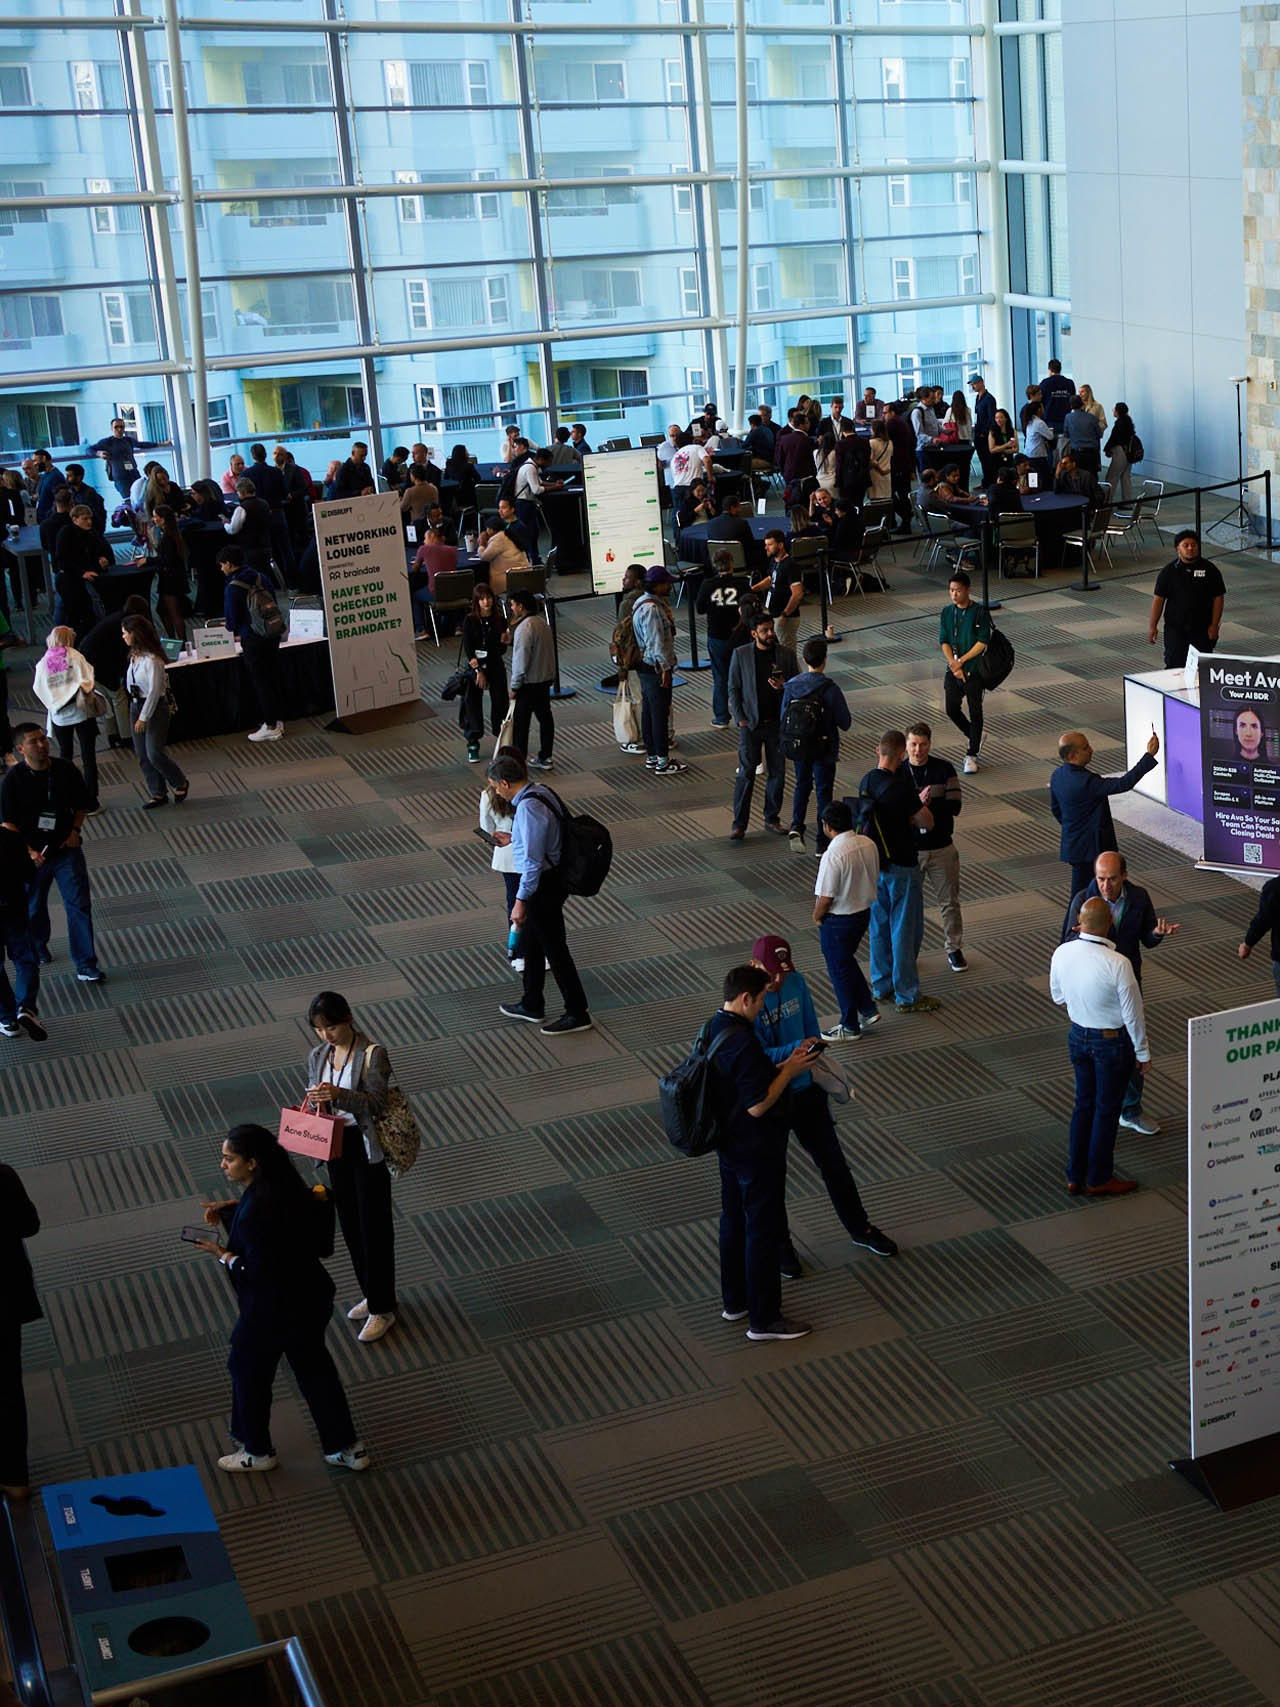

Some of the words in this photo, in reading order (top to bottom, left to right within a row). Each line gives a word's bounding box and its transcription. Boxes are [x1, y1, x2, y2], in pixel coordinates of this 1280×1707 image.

[324, 526, 397, 546] NETWORKING
[326, 544, 370, 560] LOUNGE
[343, 566, 380, 578] braindate
[331, 586, 360, 599] HAVE
[362, 581, 384, 594] YOU
[711, 588, 738, 606] 42
[332, 596, 383, 613] CHECKED
[386, 592, 397, 604] IN
[334, 614, 356, 626] FOR
[358, 608, 387, 622] YOUR
[336, 618, 402, 640] BRAINDATE?
[1209, 668, 1252, 686] Meet
[1229, 690, 1244, 698] Your
[1254, 692, 1269, 700] BDR
[1216, 812, 1230, 820] Hire
[1254, 816, 1270, 824] Your
[1221, 820, 1240, 828] Team
[1256, 824, 1274, 832] Focus
[1230, 828, 1254, 839] Closing
[1226, 1044, 1262, 1063] OUR
[284, 1125, 302, 1136] Acne
[303, 1130, 328, 1143] Studios
[1208, 1410, 1236, 1425] DISRUPT
